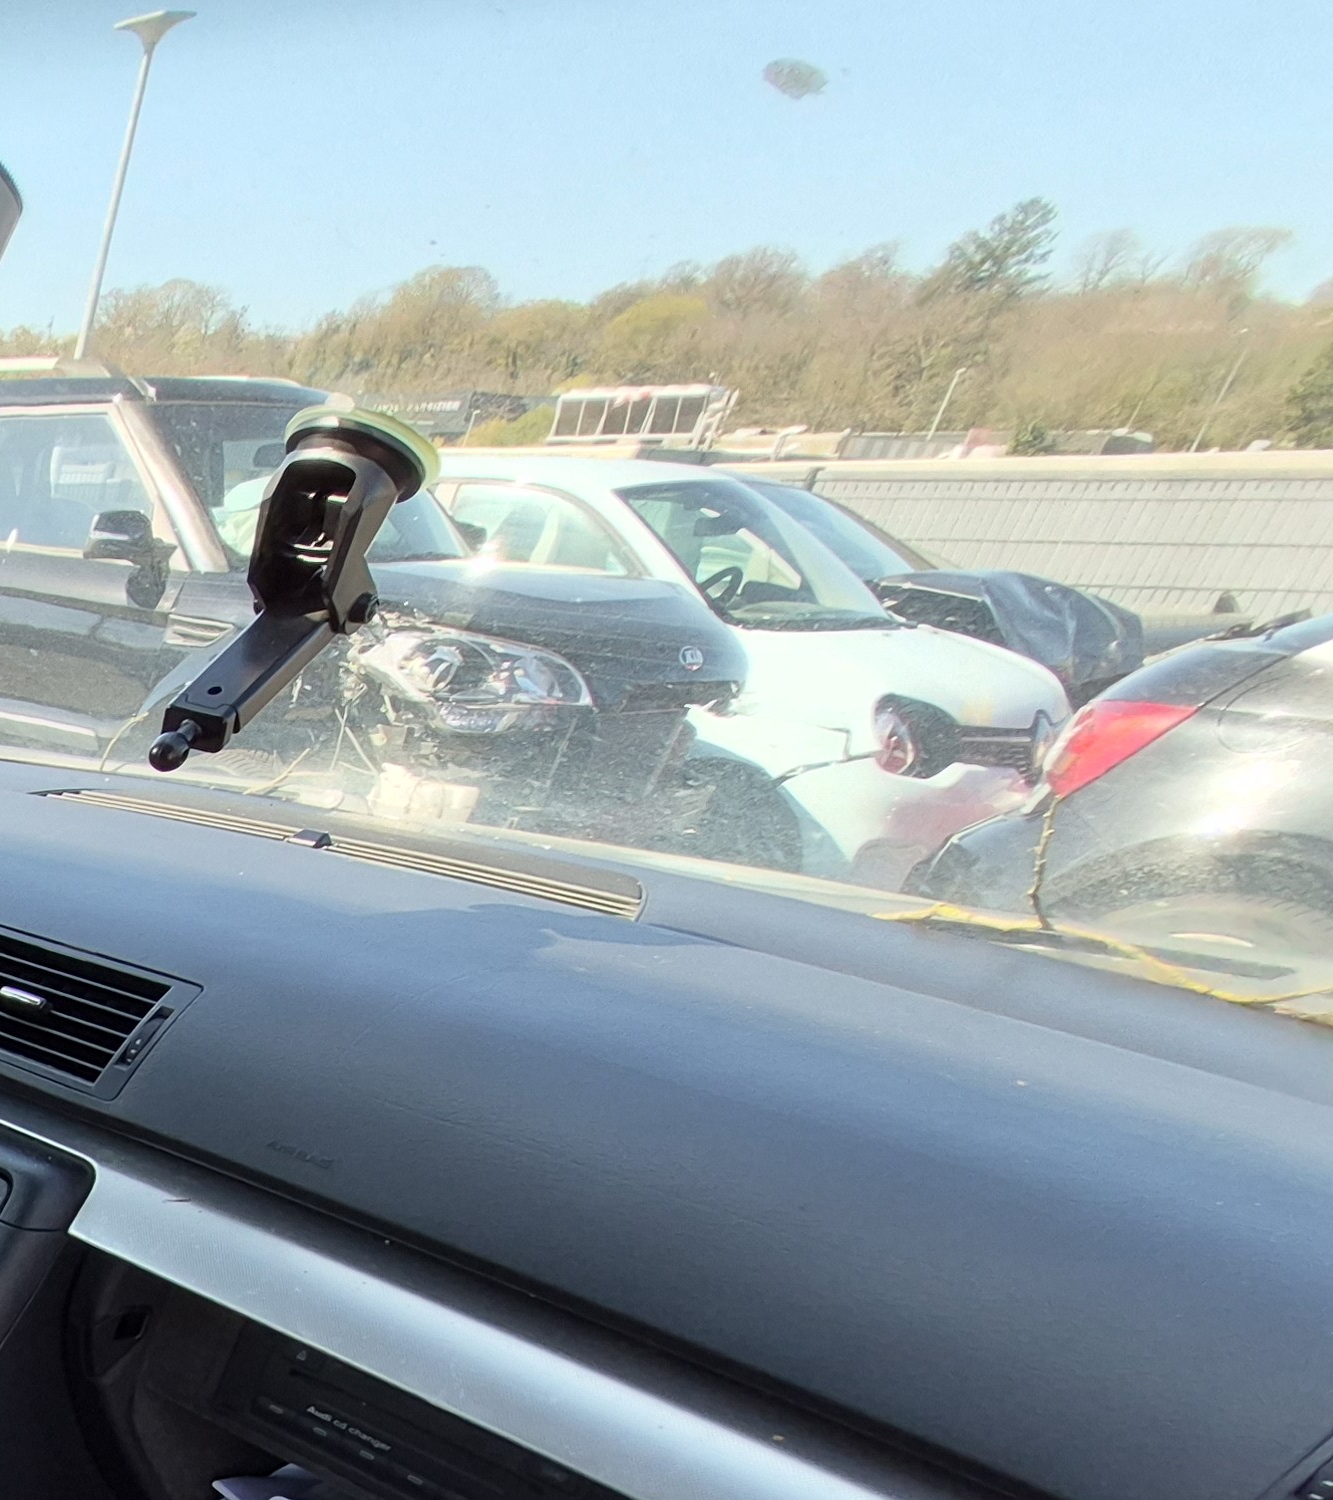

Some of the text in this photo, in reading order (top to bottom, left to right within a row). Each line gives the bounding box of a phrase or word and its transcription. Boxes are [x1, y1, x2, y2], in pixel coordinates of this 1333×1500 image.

[306, 1405, 391, 1451] Audi cd changer
